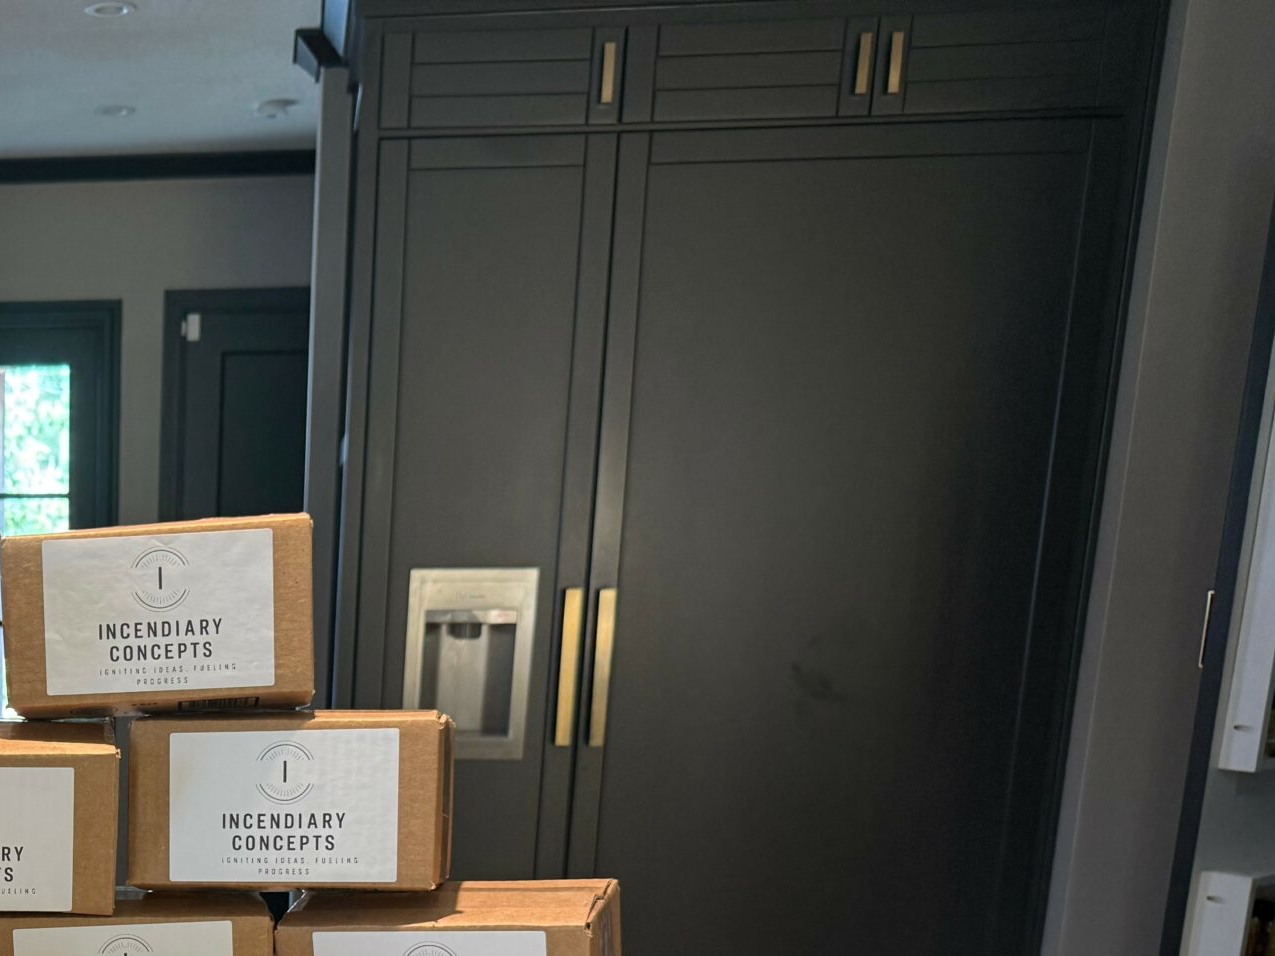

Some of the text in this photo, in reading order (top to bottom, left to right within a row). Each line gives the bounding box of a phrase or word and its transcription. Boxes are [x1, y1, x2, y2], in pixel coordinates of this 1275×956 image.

[98, 617, 223, 641] INCENDIARY
[109, 641, 213, 662] CONCEPTS
[222, 812, 346, 830] INCENDIARY
[232, 835, 335, 851] CONCEPTS
